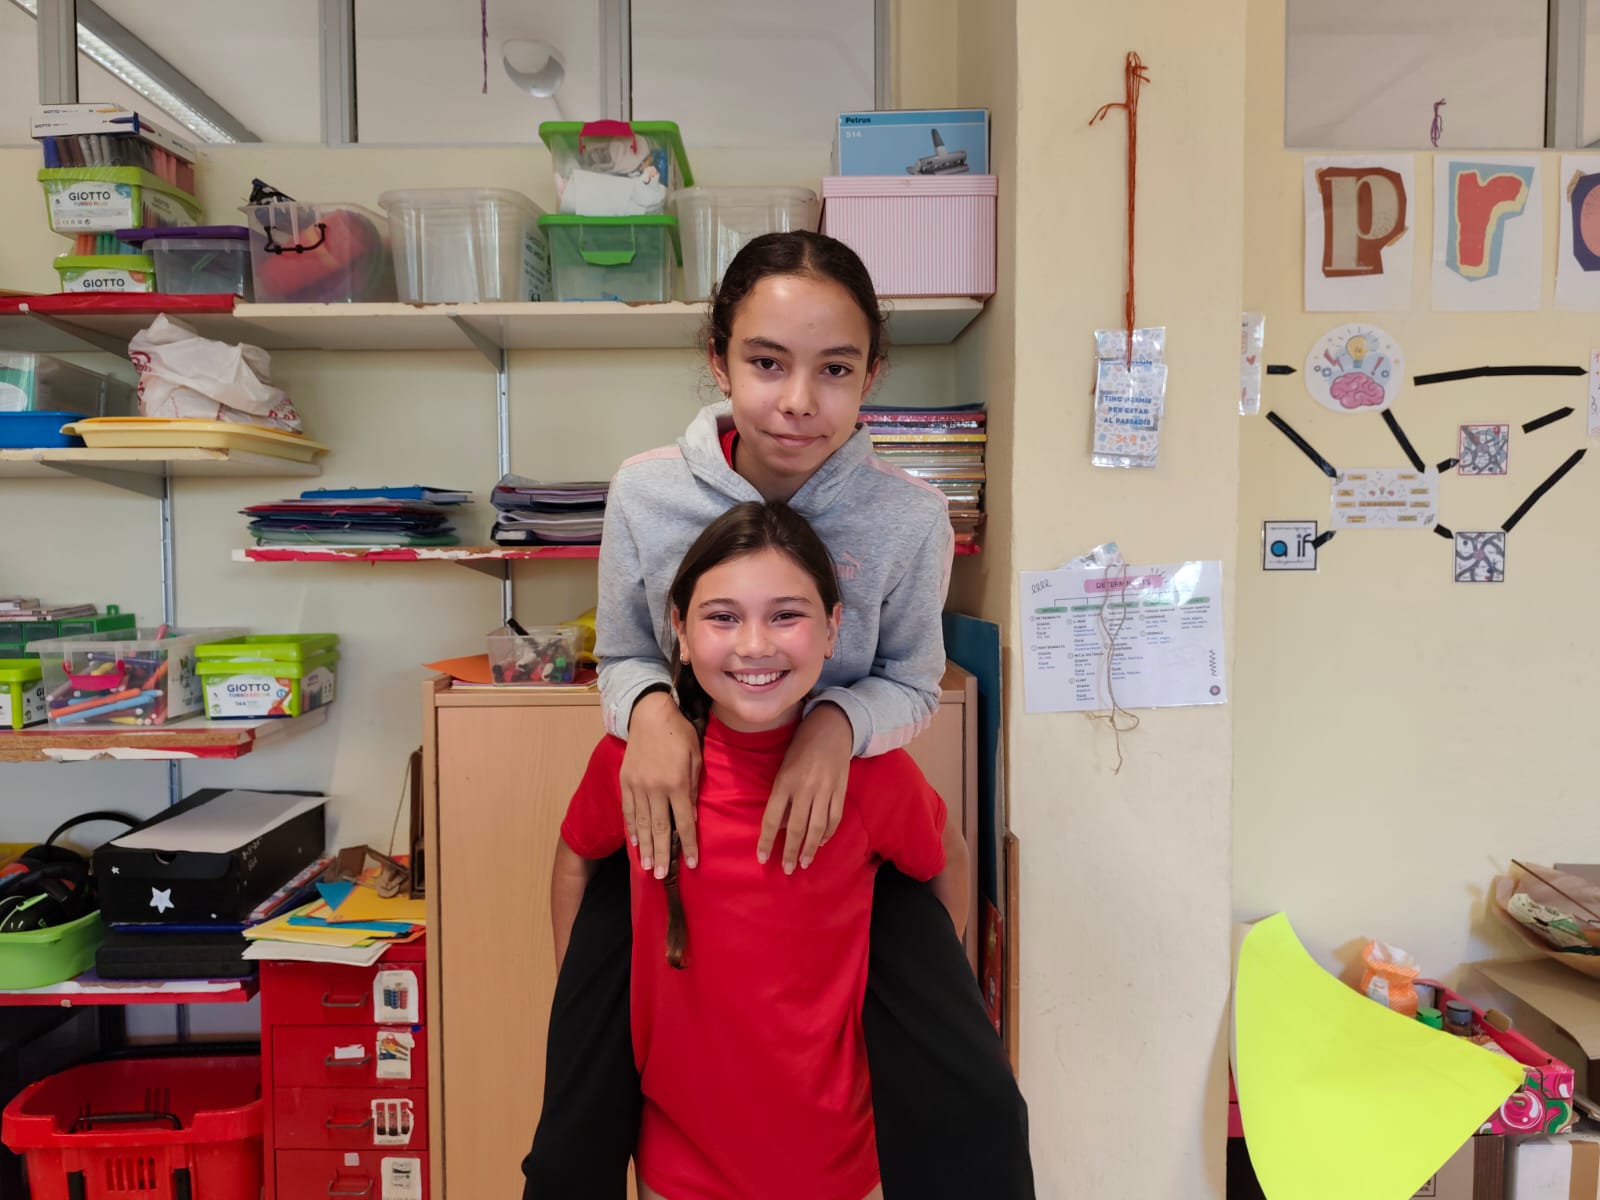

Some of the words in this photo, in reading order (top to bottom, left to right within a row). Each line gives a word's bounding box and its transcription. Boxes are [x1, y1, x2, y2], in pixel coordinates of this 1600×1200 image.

[68, 191, 111, 201] GIOTTO
[82, 278, 125, 288] GIOTTO
[227, 683, 270, 692] GIOTTO
